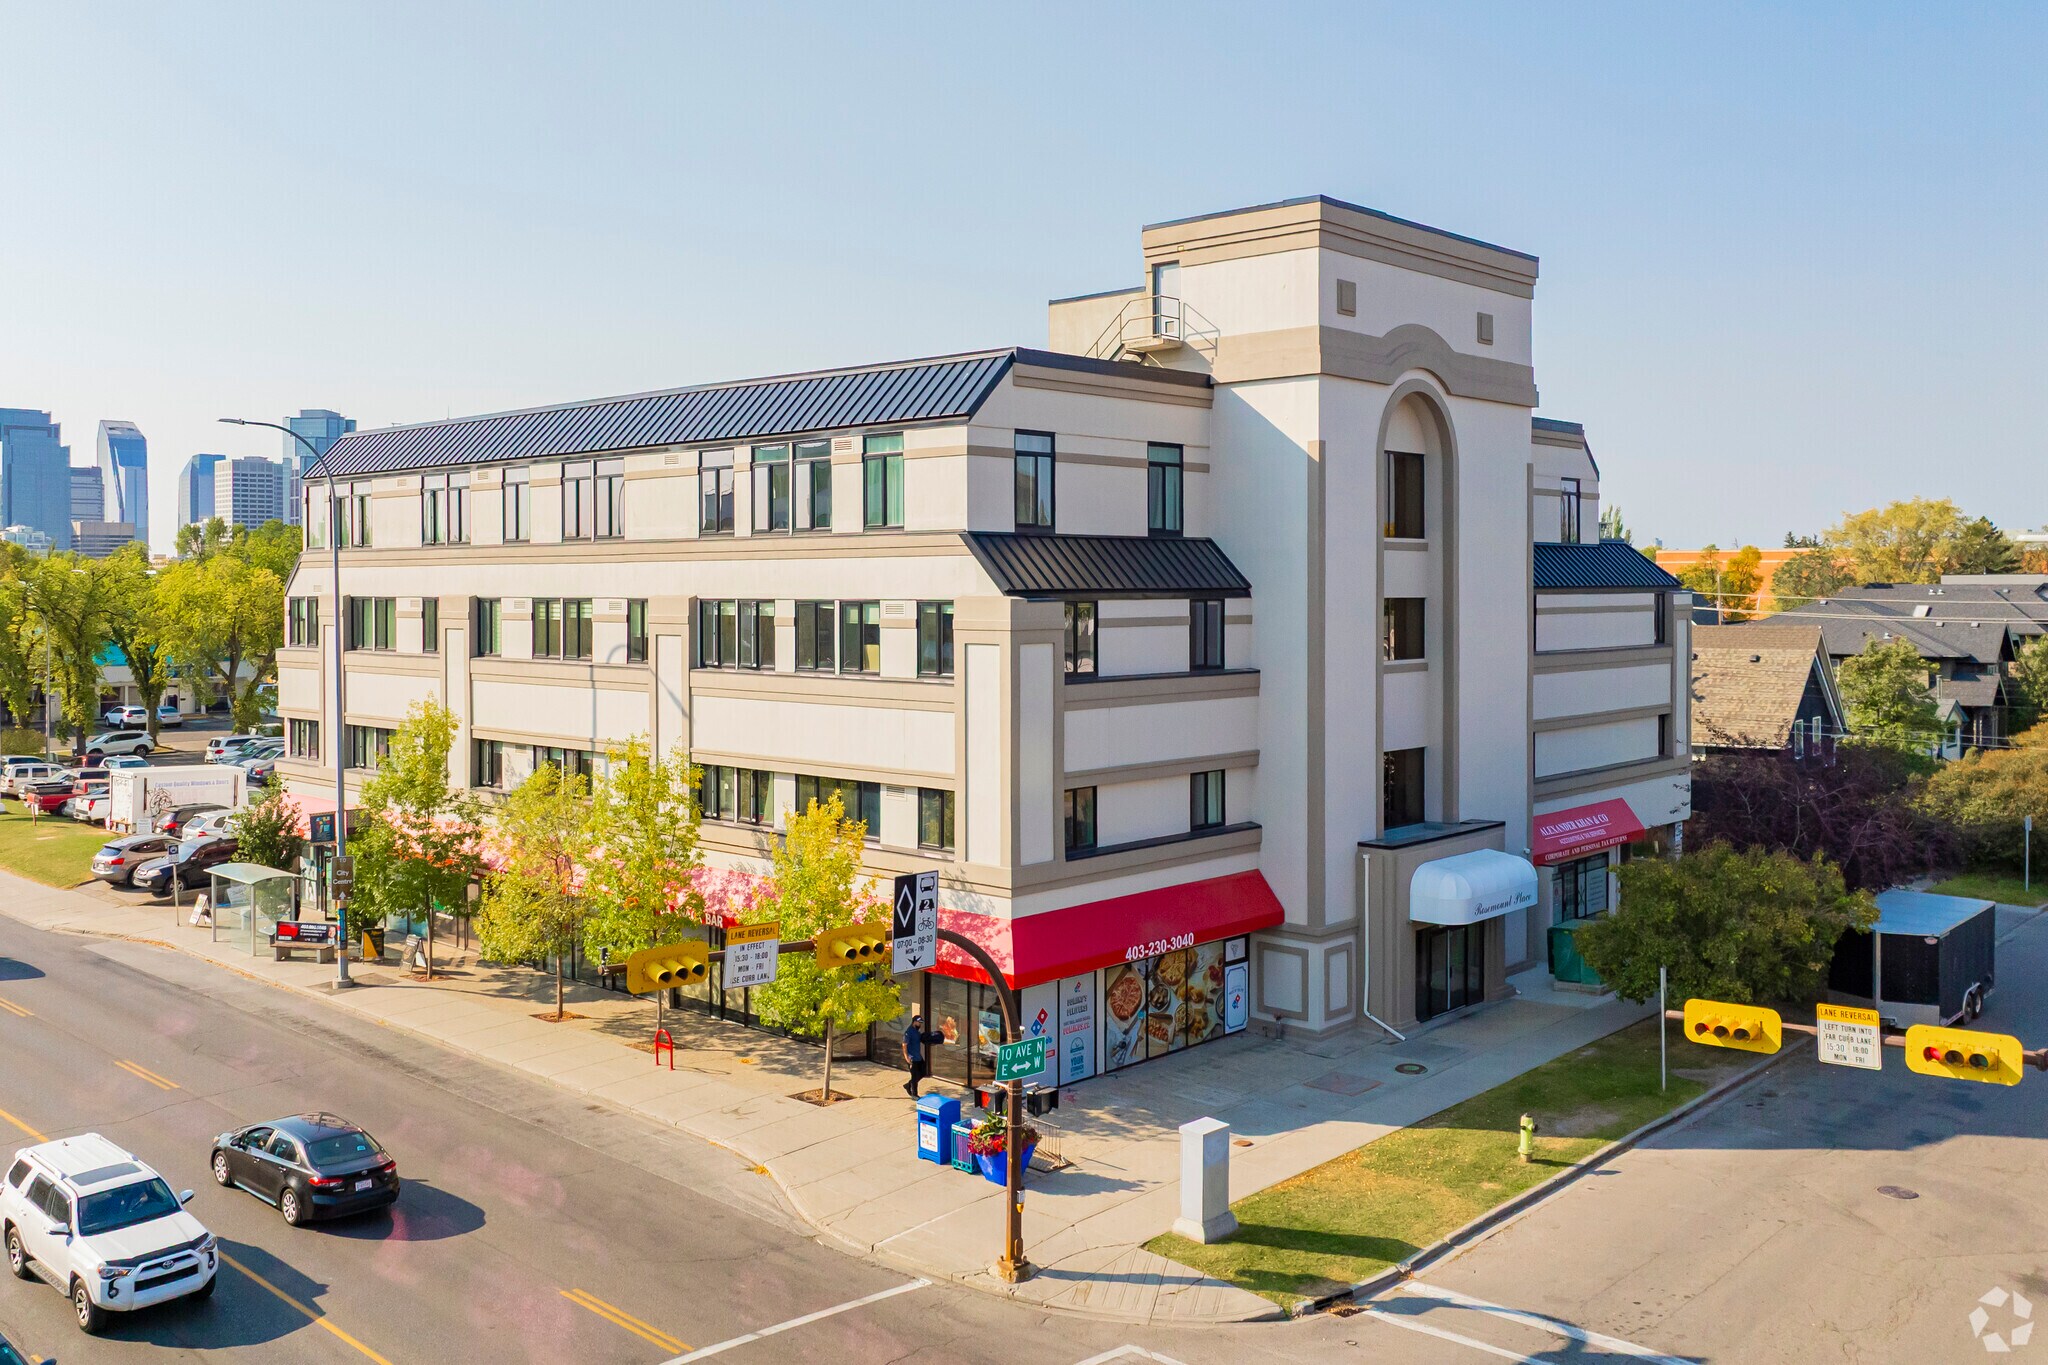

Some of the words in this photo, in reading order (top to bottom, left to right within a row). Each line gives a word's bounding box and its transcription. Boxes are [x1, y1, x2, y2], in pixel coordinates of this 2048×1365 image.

[1540, 820, 1577, 836] ALEXANDER
[1575, 816, 1595, 829] KHAN
[1598, 813, 1609, 822] CO
[1545, 849, 1570, 861] CORPORATE
[1571, 847, 1581, 856] AND
[1580, 842, 1601, 852] PERSONAL
[1601, 839, 1610, 847] TAX
[1609, 835, 1628, 845] RETURNS
[923, 900, 930, 909] 2
[1474, 895, 1512, 916] Rosemount
[1514, 892, 1531, 905] Place
[705, 912, 723, 929] BAR
[730, 929, 745, 940] LANE
[747, 927, 776, 938] REVERSAL
[739, 944, 746, 952] IN
[746, 941, 765, 951] EFFECT
[896, 939, 913, 950] 07:00
[917, 934, 933, 945] 08:30
[1125, 932, 1194, 961] 403-230-3040
[734, 953, 749, 962] 15:30
[754, 951, 768, 960] 18:00
[905, 947, 914, 955] MON
[737, 964, 749, 973] MON
[755, 962, 764, 970] FRI
[741, 974, 756, 983] CURB
[757, 972, 770, 981] LAN
[1820, 1009, 1837, 1018] LANE
[1840, 1010, 1875, 1022] REVERSAL
[1824, 1023, 1838, 1031] LEFT
[1841, 1025, 1856, 1033] TURN
[1858, 1028, 1872, 1036] INTO
[1838, 1035, 1854, 1043] CURB
[1856, 1037, 1872, 1045] LANE
[1001, 1048, 1012, 1061] 10
[1016, 1043, 1032, 1058] AVE
[1036, 1041, 1043, 1053] N
[1826, 1042, 1845, 1052] 15:30
[1852, 1046, 1869, 1054] 18:00
[1001, 1063, 1008, 1076] E
[1033, 1056, 1041, 1068] W
